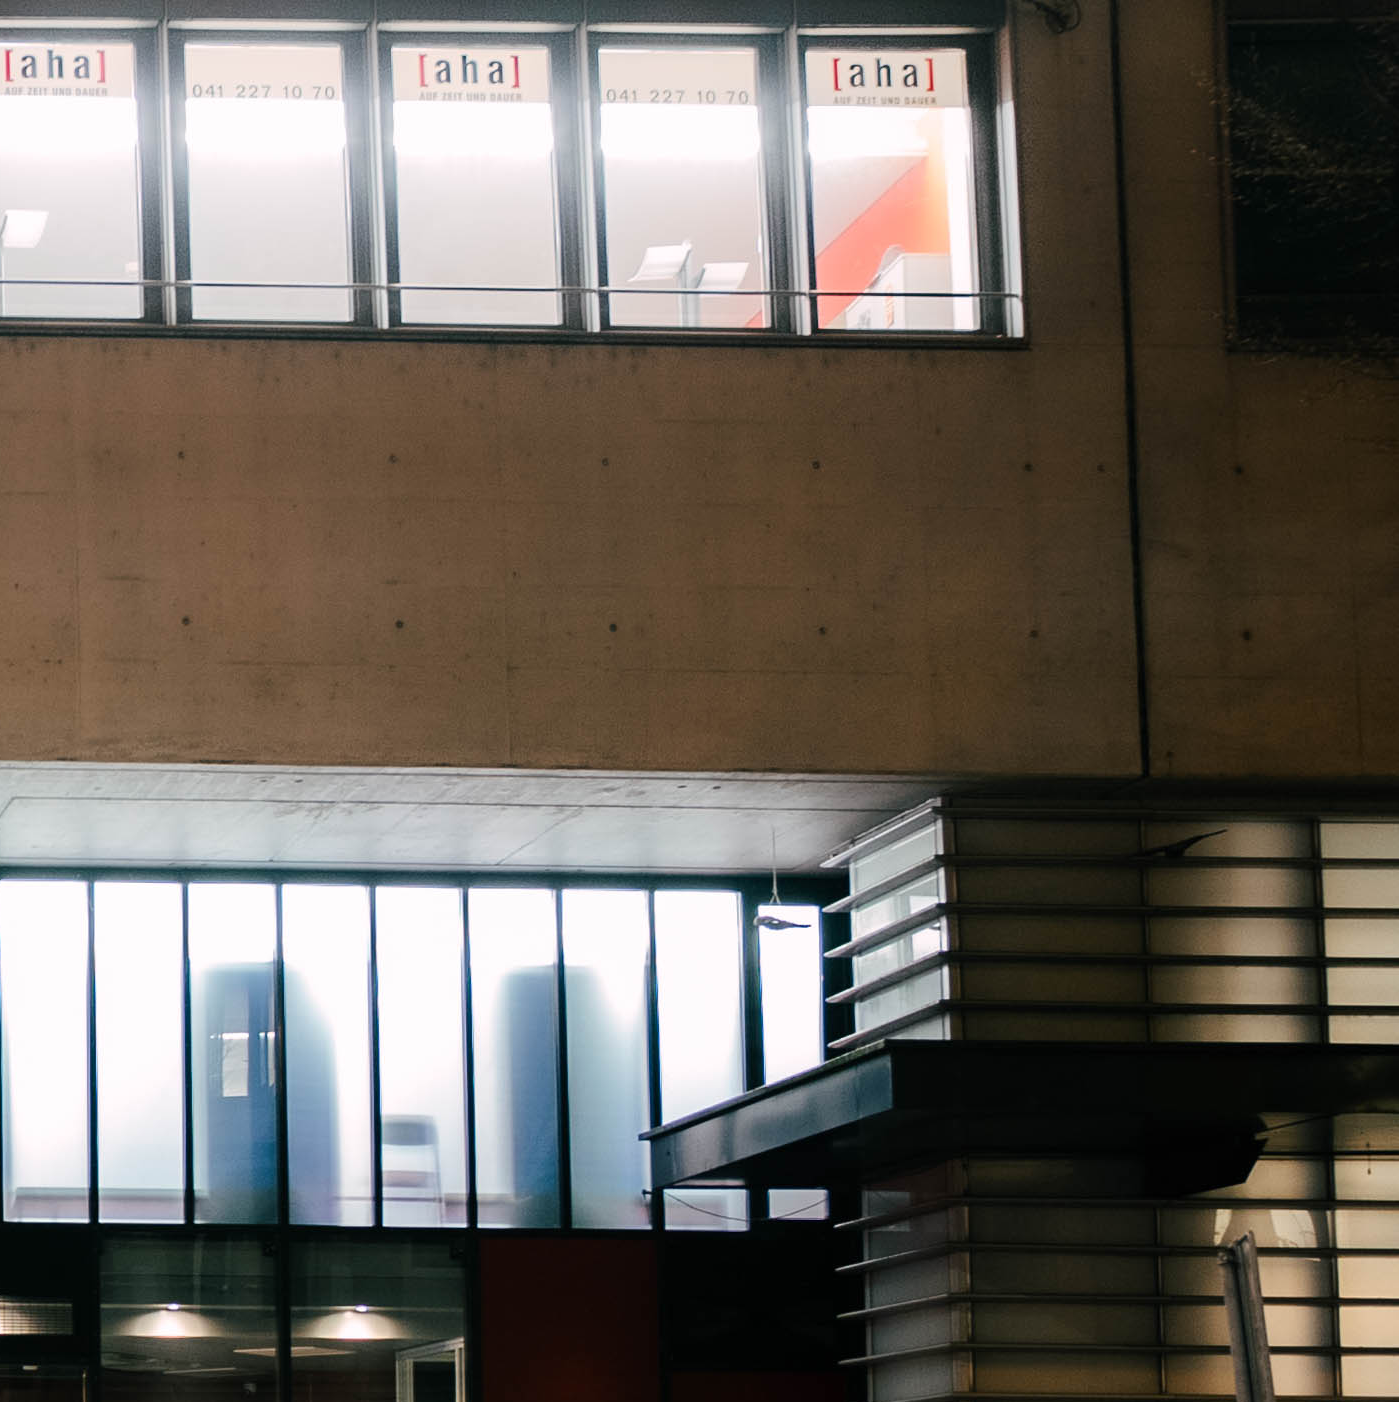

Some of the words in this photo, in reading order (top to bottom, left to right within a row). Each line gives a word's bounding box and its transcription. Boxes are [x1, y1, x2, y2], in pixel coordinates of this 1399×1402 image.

[4, 49, 106, 84] [aha]
[418, 54, 521, 88] [aha]
[832, 58, 935, 92] [aha]
[192, 84, 223, 98] 041
[235, 84, 271, 98] 227
[283, 86, 303, 99] 10
[313, 86, 335, 100] 70
[606, 88, 637, 103] 041
[649, 89, 685, 104] 227
[697, 90, 717, 104] 10
[725, 90, 749, 104] 70
